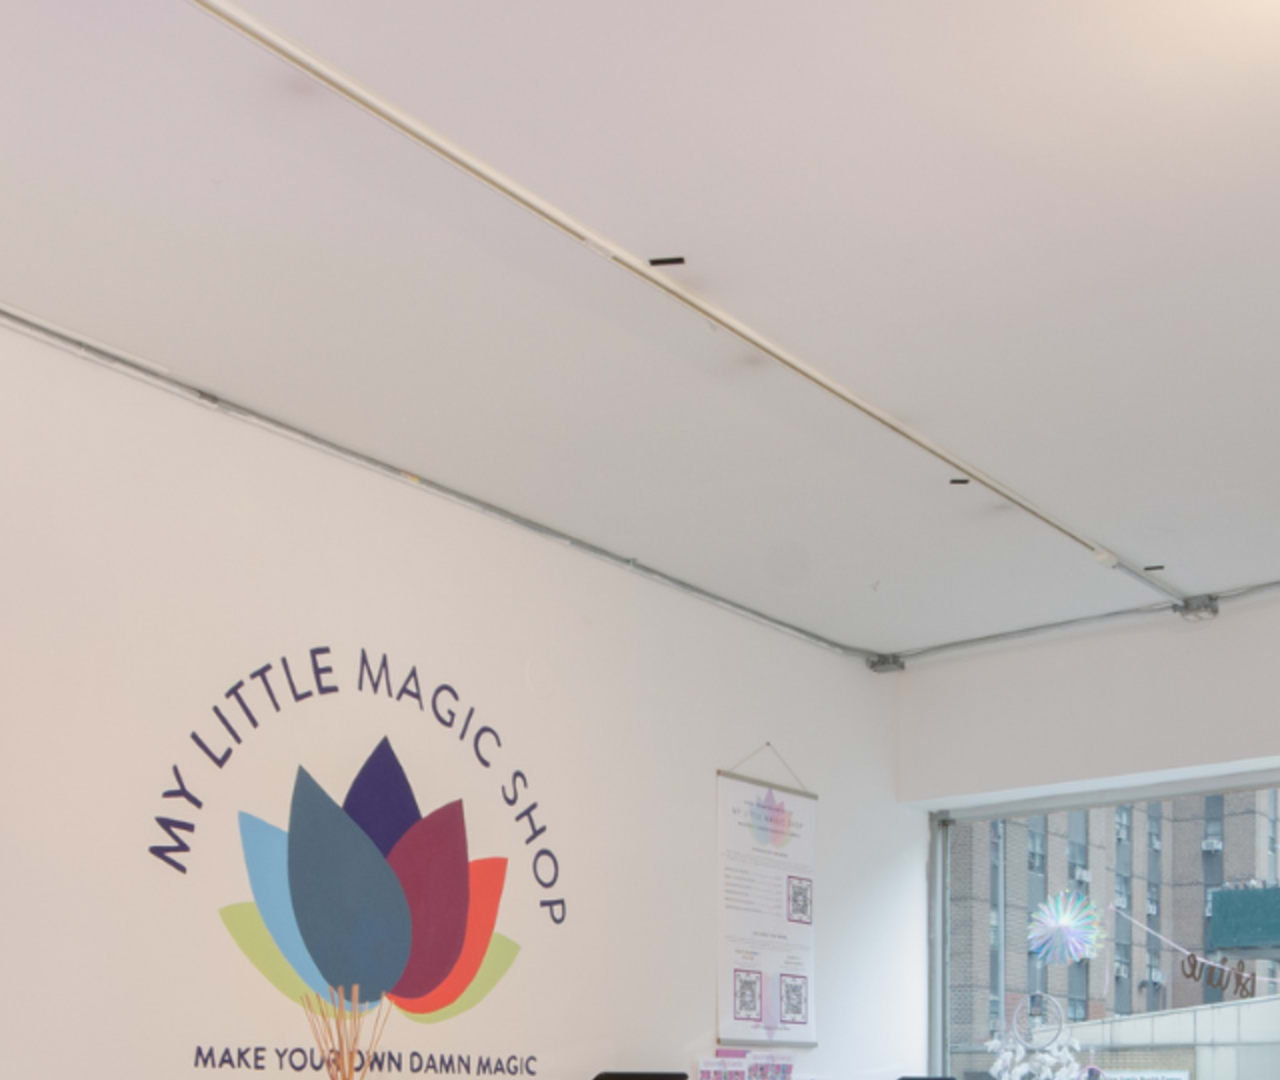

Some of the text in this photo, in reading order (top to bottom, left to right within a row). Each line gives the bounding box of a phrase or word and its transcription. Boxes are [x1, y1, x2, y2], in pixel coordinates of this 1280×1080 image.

[148, 646, 567, 925] MY LITTLE MAGIC SHOP
[193, 1046, 267, 1071] MAKE
[409, 1050, 471, 1076] DAMN
[476, 1054, 538, 1077] MAGIC
